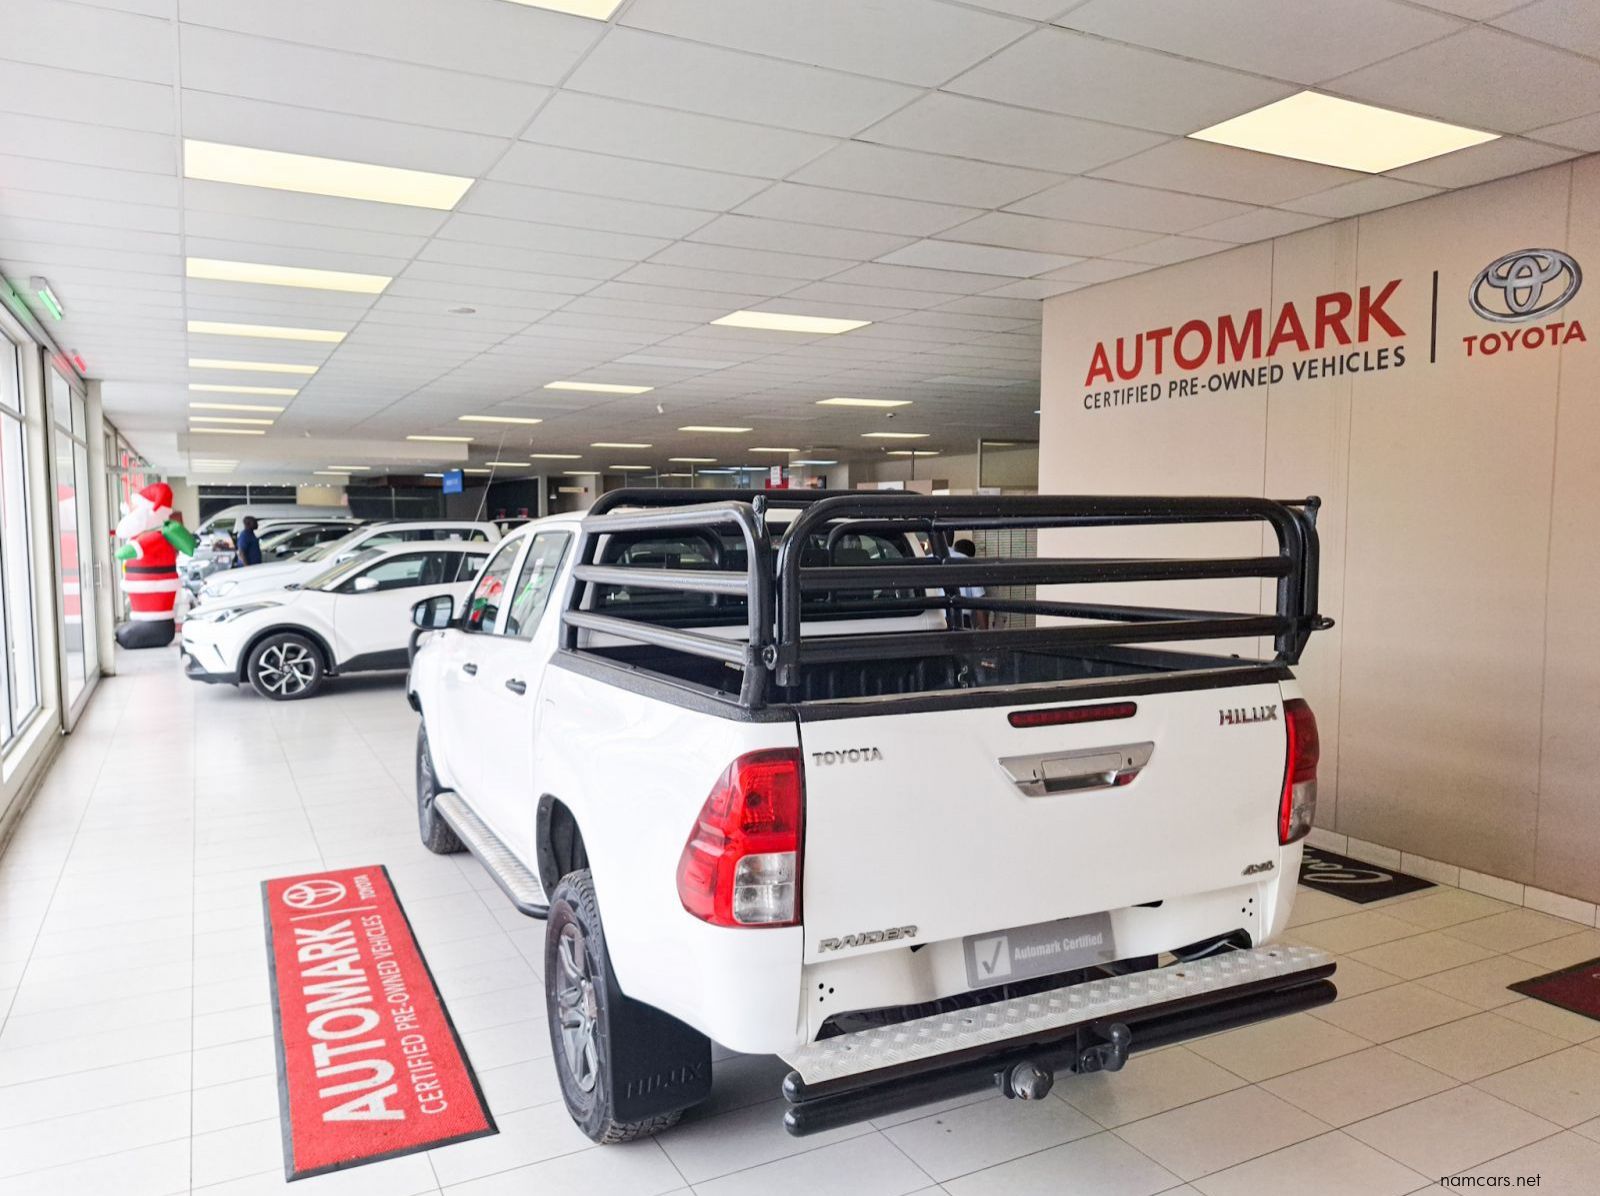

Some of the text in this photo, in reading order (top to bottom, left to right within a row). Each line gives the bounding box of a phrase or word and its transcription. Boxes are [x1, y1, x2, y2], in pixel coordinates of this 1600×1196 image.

[1085, 278, 1406, 387] AUTOMARK
[1463, 320, 1588, 357] TOYOTA
[1083, 345, 1406, 410] CERTIFIED PRE-OWNED VEHICLES
[1219, 704, 1278, 726] HILUX
[812, 745, 884, 766] TOYOTA
[818, 924, 918, 953] RAIDER
[1014, 931, 1104, 961] Automark Certified
[294, 919, 406, 1122] AUTOMARK
[361, 914, 449, 1116] CERTIFIED PRE-OWNED VEHICLES
